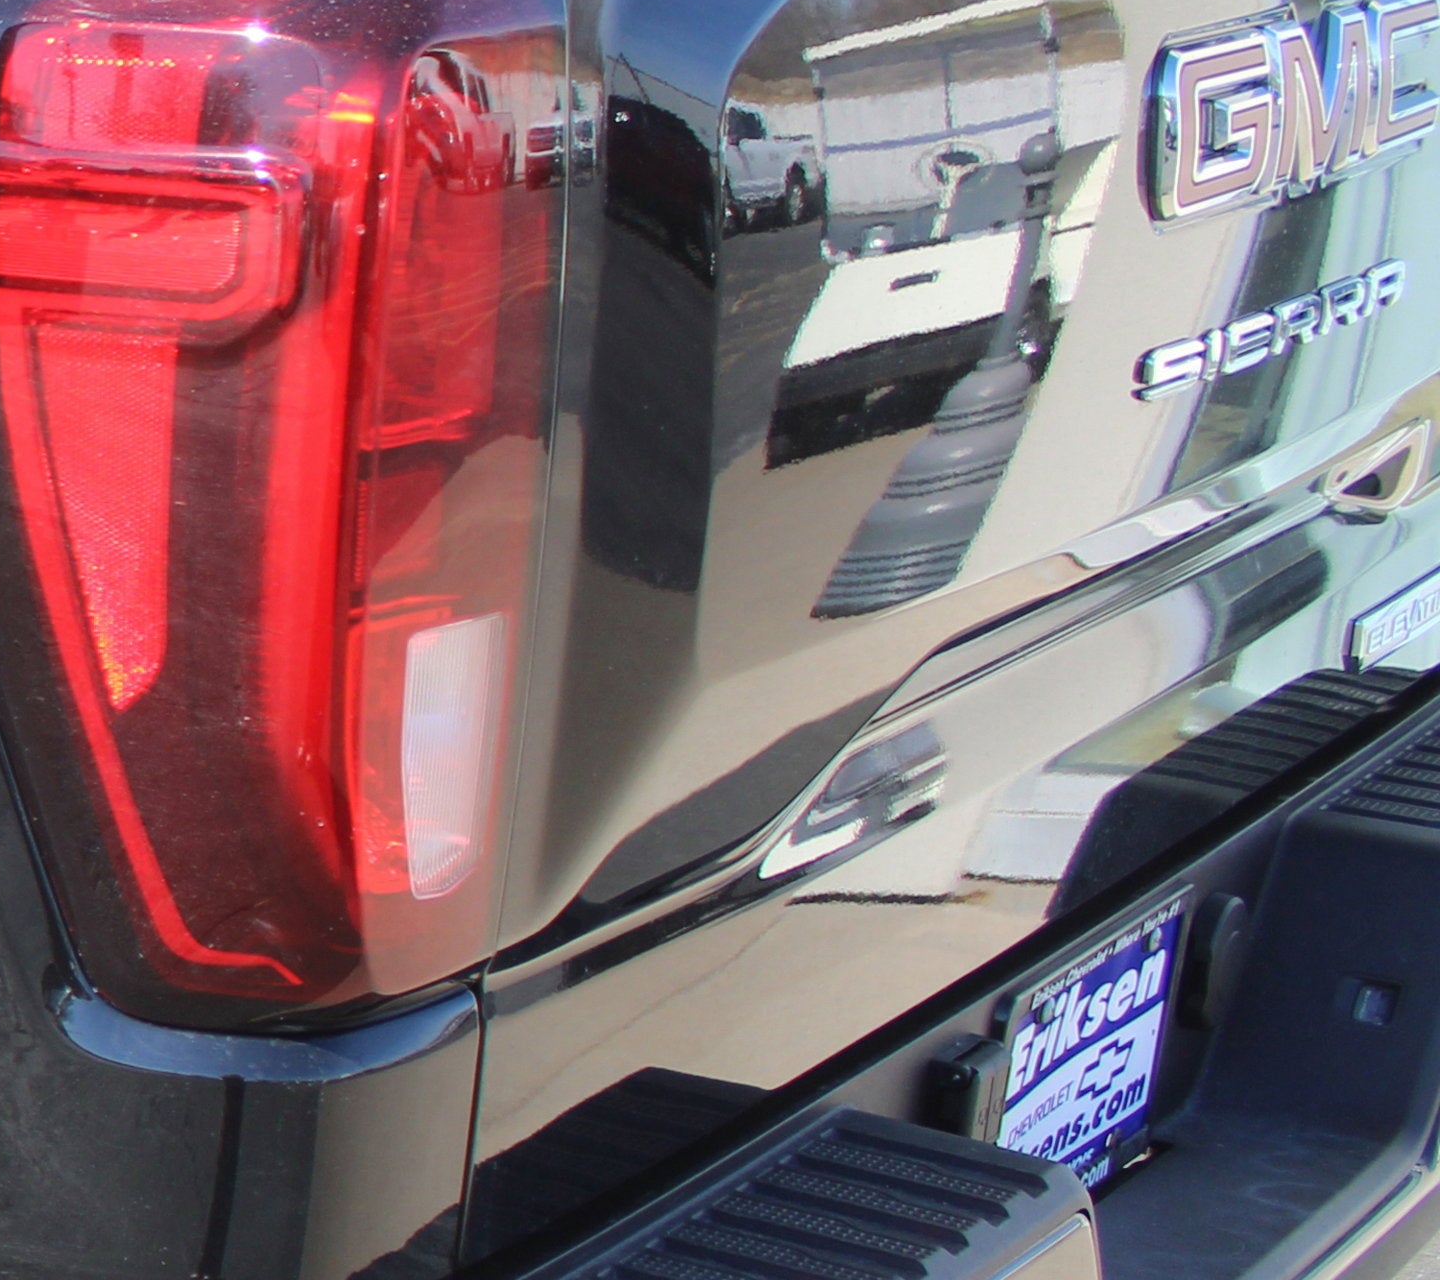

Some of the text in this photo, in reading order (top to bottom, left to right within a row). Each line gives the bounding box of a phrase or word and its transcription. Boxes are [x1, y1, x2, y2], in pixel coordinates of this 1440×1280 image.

[1132, 257, 1406, 402] SIERRA
[1004, 948, 1167, 1103] Eriksen
[1006, 1079, 1076, 1151] CHEVROLET
